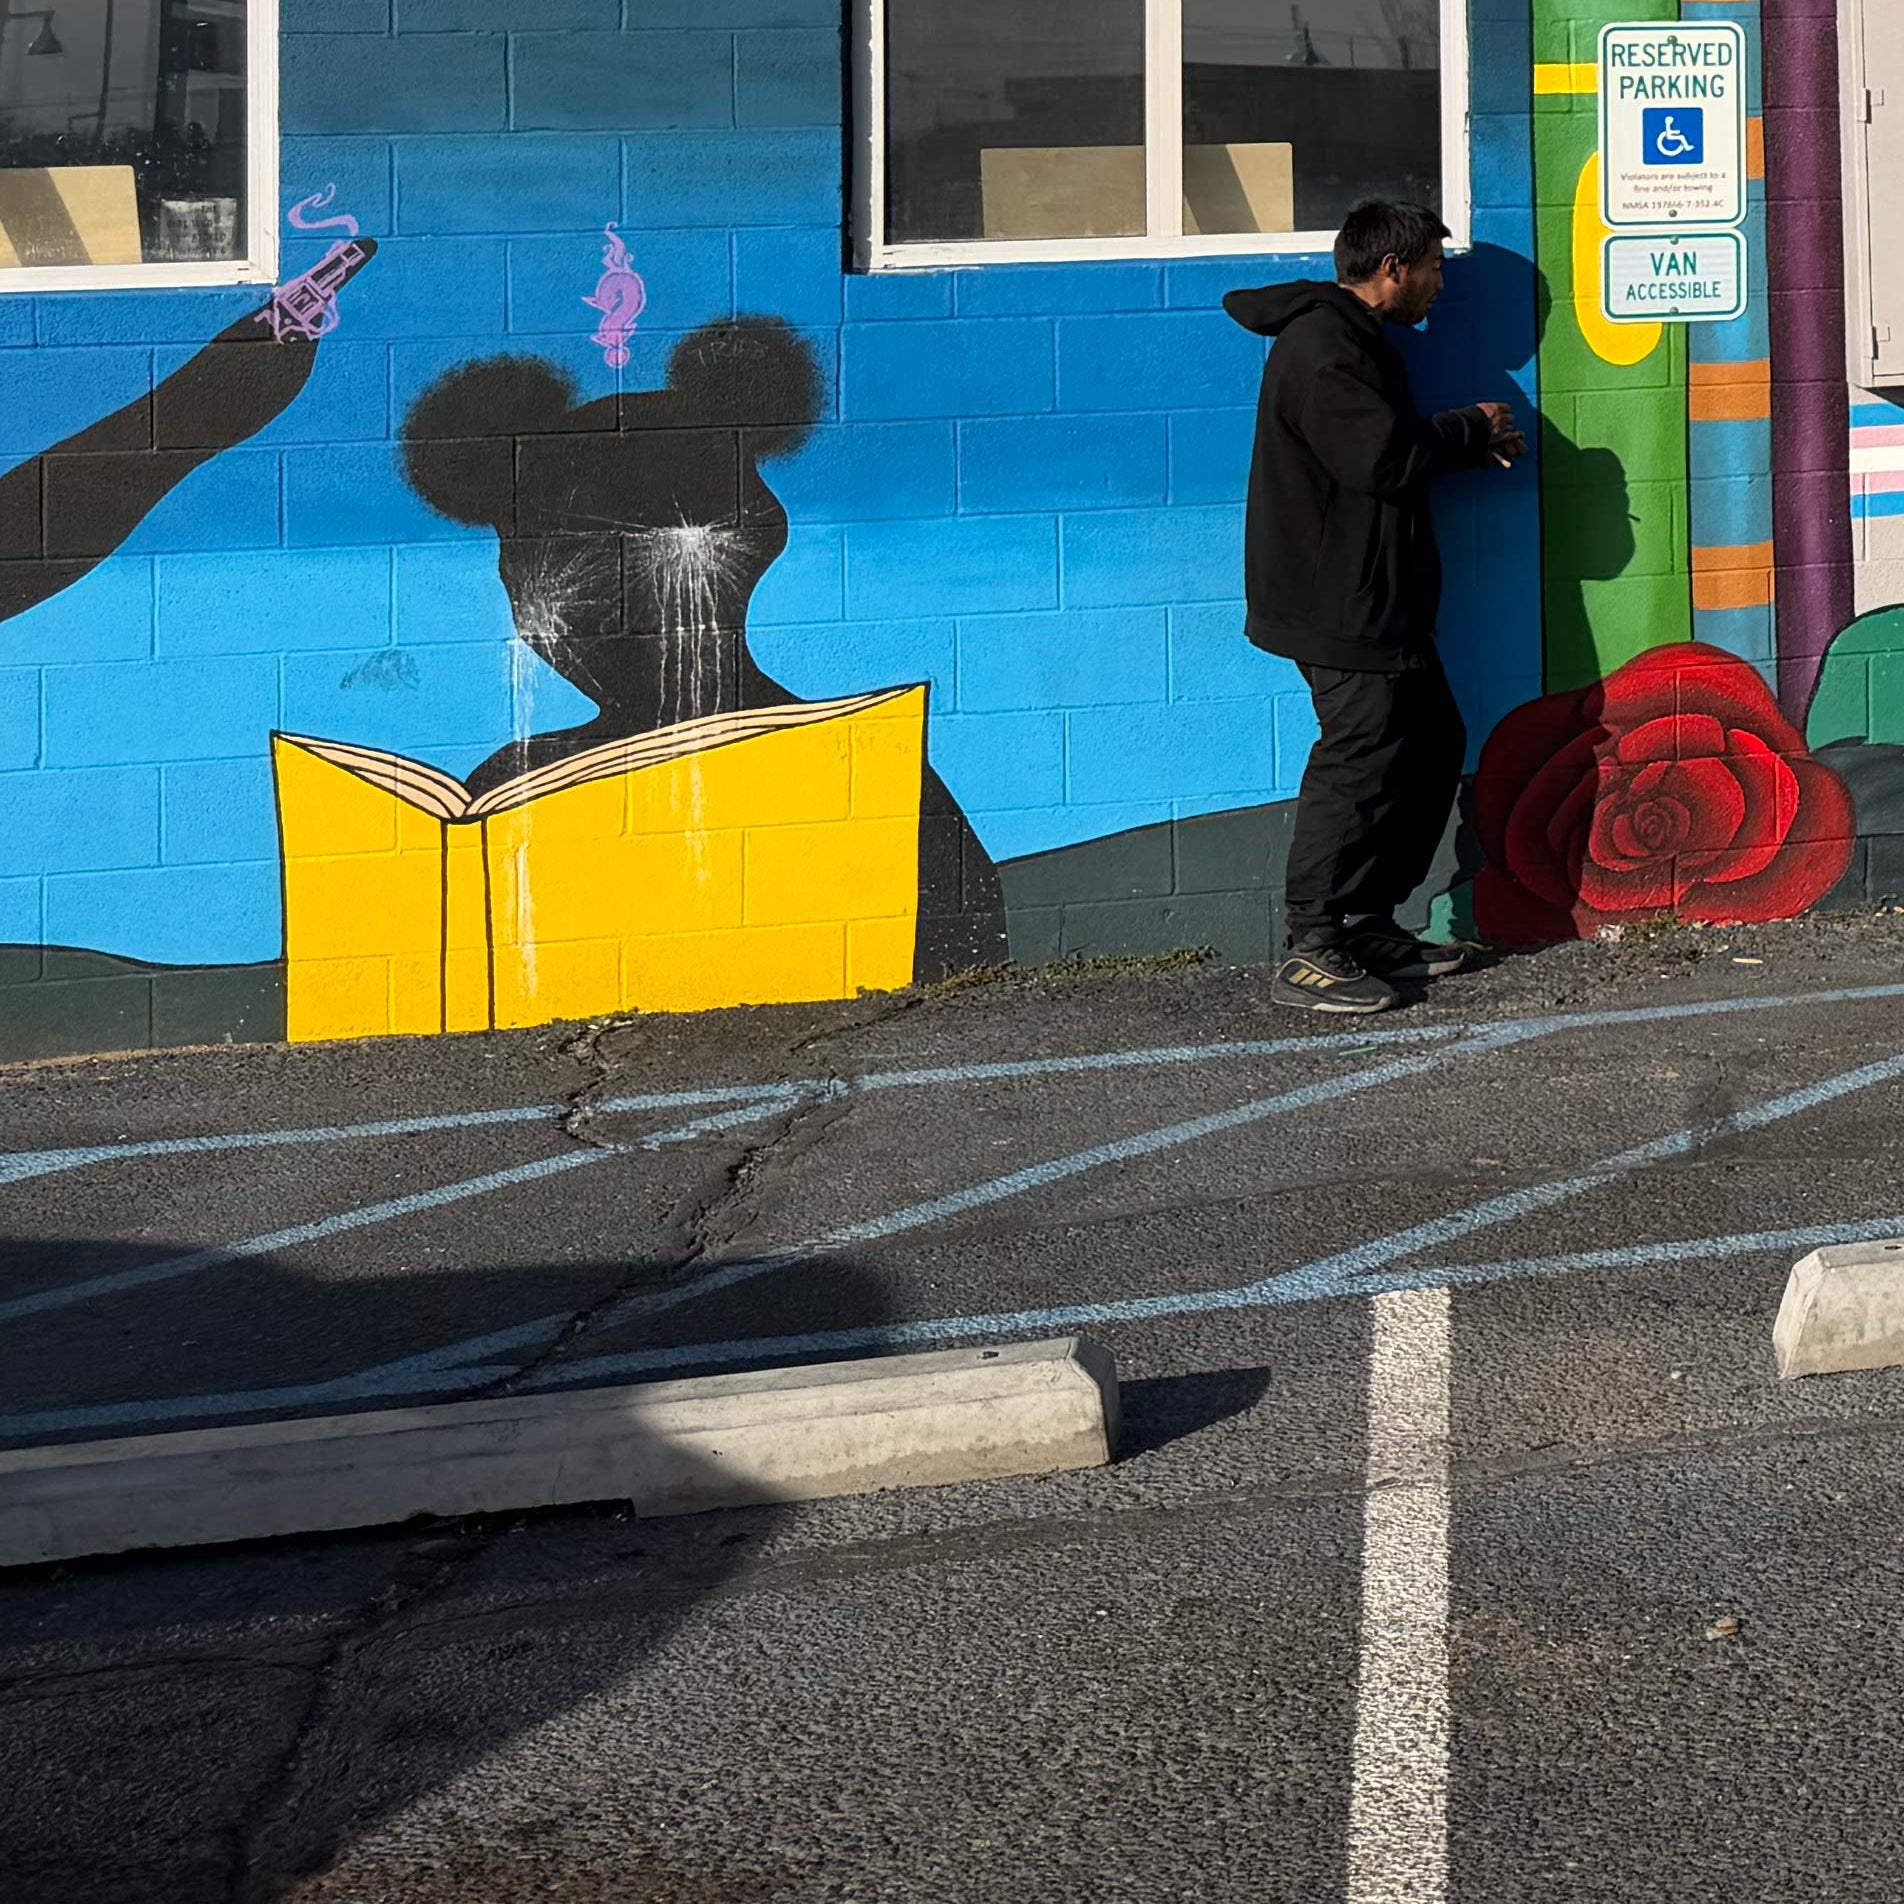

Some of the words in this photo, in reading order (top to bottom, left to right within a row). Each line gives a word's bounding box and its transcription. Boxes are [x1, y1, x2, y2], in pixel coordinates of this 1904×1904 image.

[1611, 42, 1733, 68] RESERVED
[1619, 74, 1725, 100] PARKING
[1649, 251, 1698, 277] VAN
[1625, 281, 1722, 302] ACCESSIBLE
